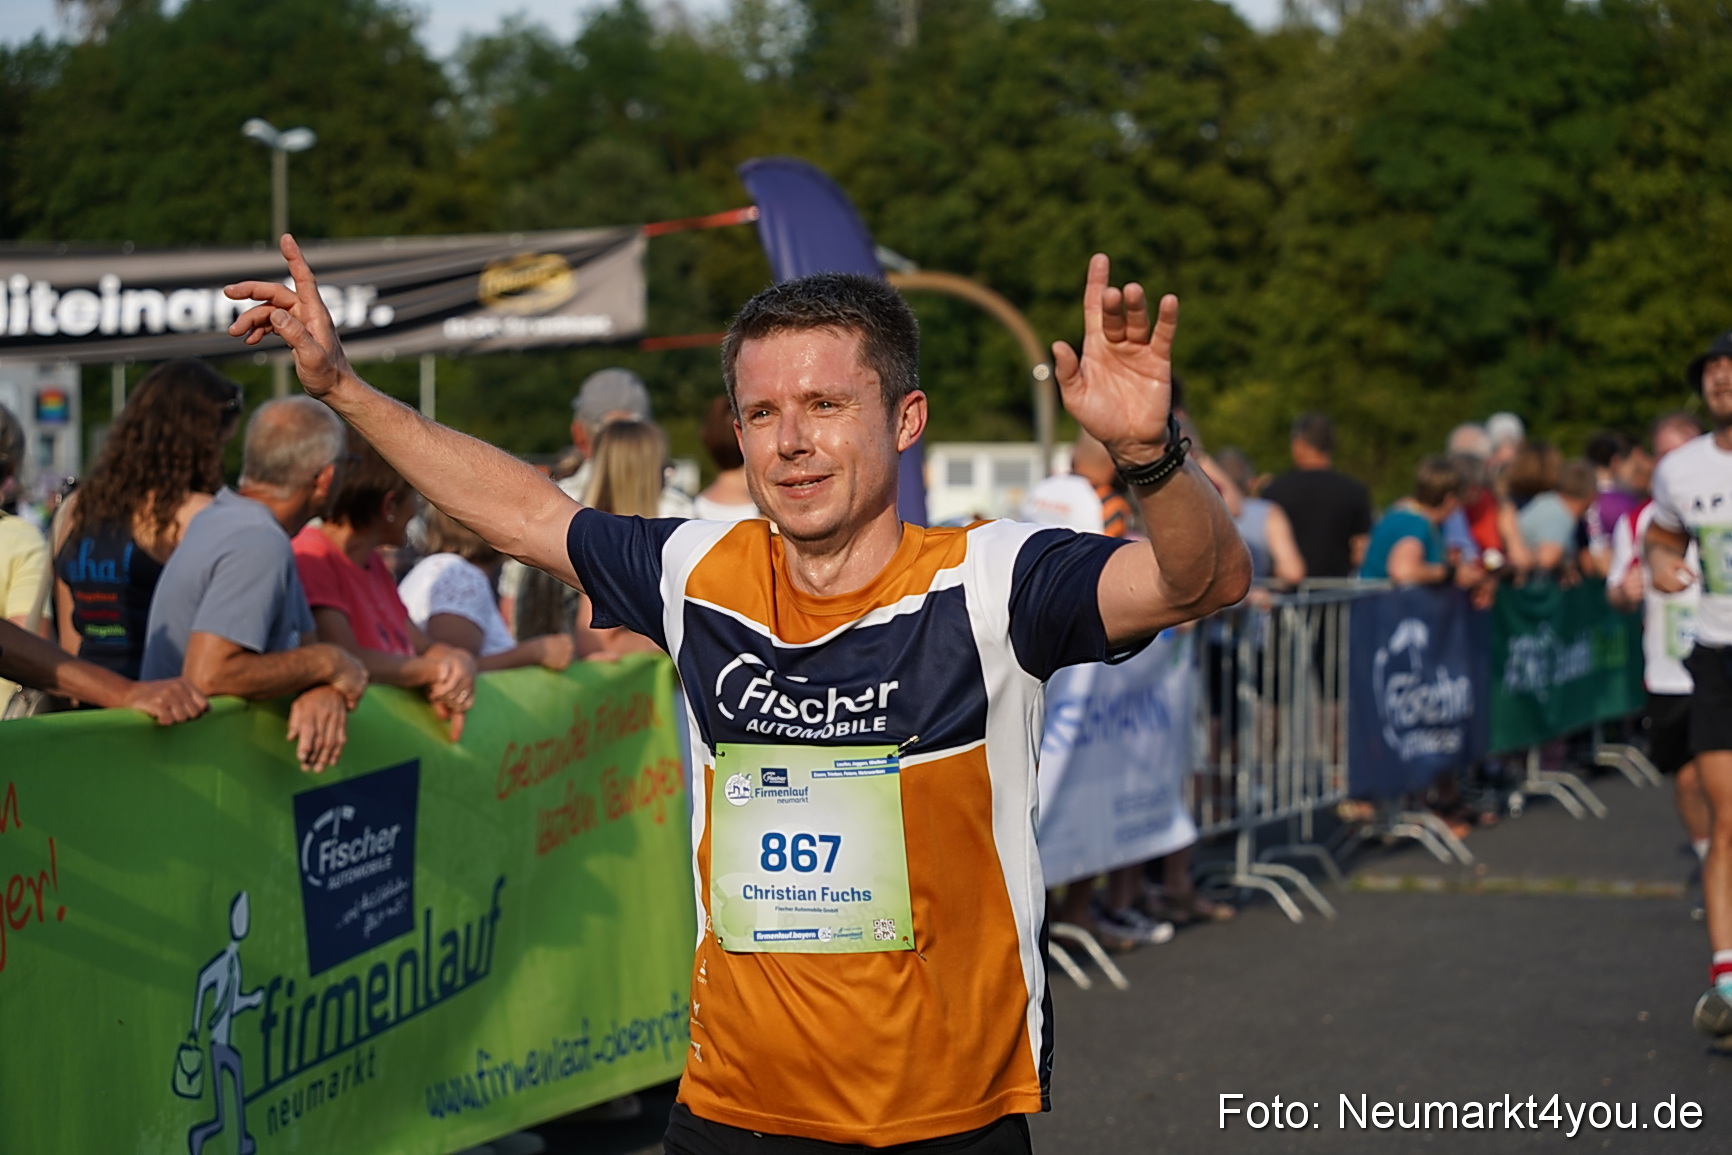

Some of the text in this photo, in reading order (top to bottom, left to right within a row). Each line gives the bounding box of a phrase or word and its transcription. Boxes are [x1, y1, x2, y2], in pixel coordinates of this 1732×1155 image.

[0, 273, 395, 336] iteinaner.
[738, 677, 899, 724] Fischer
[746, 716, 887, 739] AUTOMOBILE
[755, 786, 809, 797] Firmenlauf
[318, 824, 401, 875] Fischer
[327, 853, 394, 890] AUTOMOBILE
[761, 832, 842, 873] 867
[0, 836, 66, 973] er!
[743, 884, 872, 902] Christian Fuchs
[756, 931, 817, 940] firmenlauf.bayern
[260, 874, 506, 1090] firmenlauf
[266, 1046, 376, 1136] neumarkt
